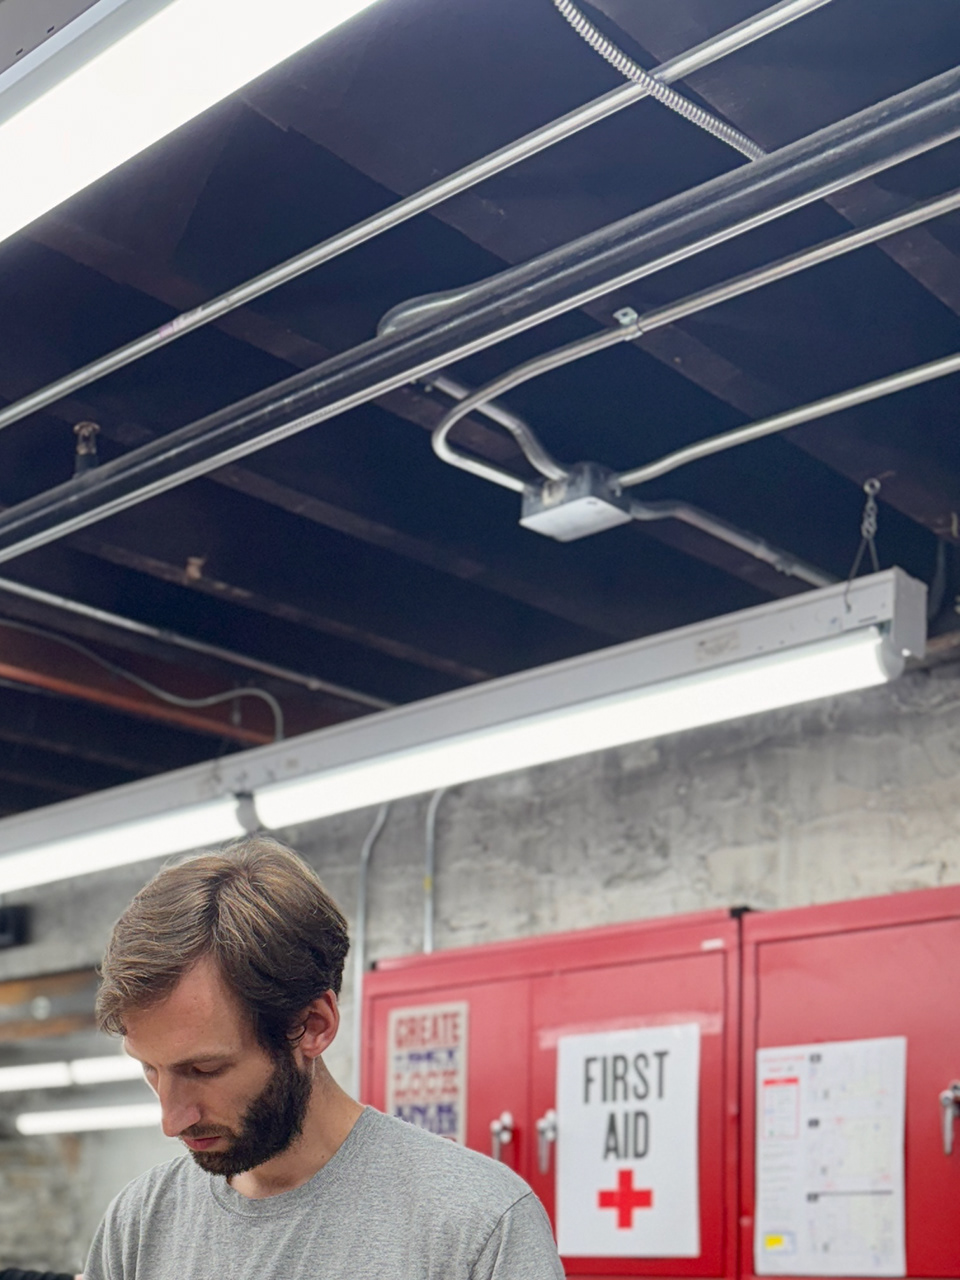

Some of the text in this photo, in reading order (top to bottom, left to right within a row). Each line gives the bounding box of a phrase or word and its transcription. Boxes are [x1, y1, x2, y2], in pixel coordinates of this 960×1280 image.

[395, 1012, 459, 1049] CREATE
[584, 1050, 669, 1103] FIRST
[603, 1111, 649, 1160] AID
